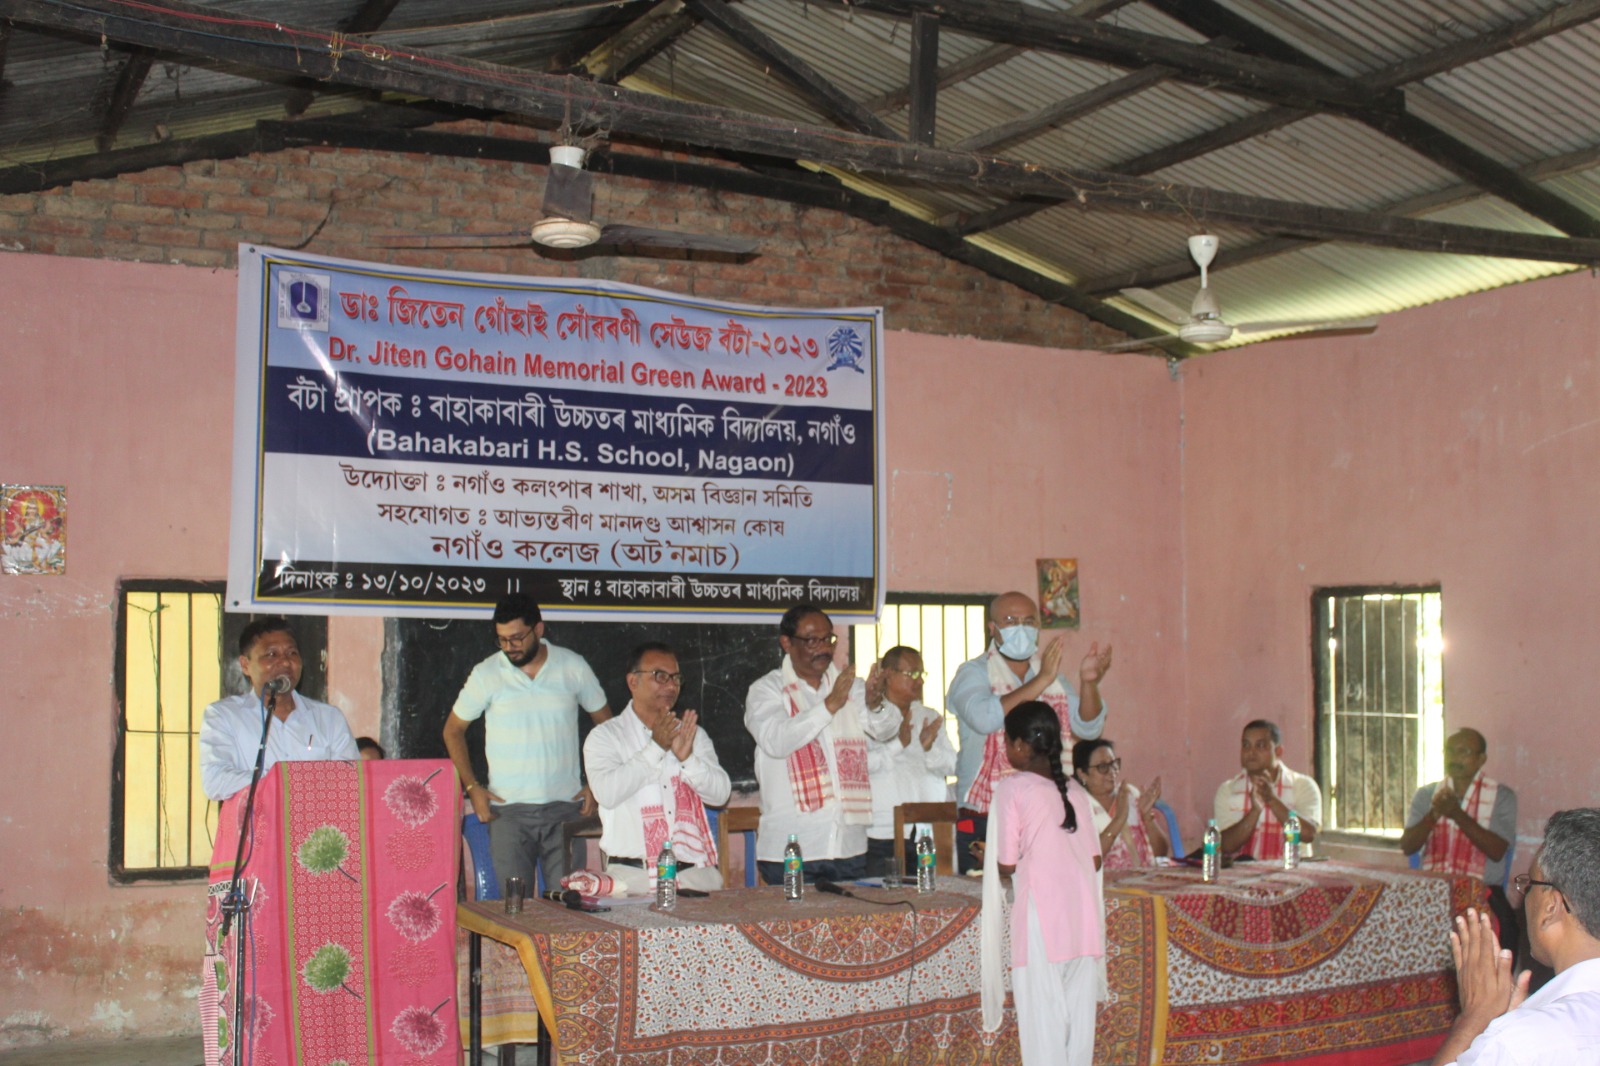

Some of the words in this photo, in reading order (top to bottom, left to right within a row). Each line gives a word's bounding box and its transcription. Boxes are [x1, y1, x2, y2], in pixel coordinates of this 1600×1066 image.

[339, 290, 379, 321] ডাঃ
[387, 286, 465, 329] জিতেন
[474, 296, 549, 340] গোঁহাই
[650, 314, 712, 354] সেউজ
[329, 336, 360, 362] Dr.
[368, 340, 426, 369] Jiten
[435, 346, 516, 374] Gohain
[524, 353, 624, 383] Memorial
[631, 363, 696, 388] Green
[702, 369, 766, 394] Award
[785, 374, 828, 398] 2023
[286, 375, 327, 414] বঁটা
[428, 393, 546, 429] বাহাকাবাৰী
[550, 397, 626, 433] উচ্চতৰ
[632, 403, 715, 439] মাধ্যমিক
[722, 407, 803, 445] বিদ্যালয়,
[808, 415, 856, 446] নগাঁও
[367, 430, 529, 460] (Bahakabari
[538, 440, 588, 462] H.S.
[598, 443, 690, 472] School,
[698, 450, 794, 477] Nagaon)
[339, 461, 428, 492] উদ্যোক্তা
[453, 470, 505, 495] নগাঁও
[512, 478, 592, 500] কলংপাৰ
[598, 482, 647, 505] শাখা,
[653, 485, 695, 504] অসম
[703, 482, 757, 506] বিজ্ঞান
[763, 485, 814, 509] সমিতি
[377, 503, 471, 525] সহযোগত
[493, 505, 593, 532] আভ্যন্তৰীণ
[600, 514, 661, 533] মানদণ্ড
[666, 516, 736, 536] আশ্বাসন
[743, 519, 785, 537] কোষ
[430, 529, 504, 561] নগাঁও
[513, 540, 601, 567] কলেজ
[279, 567, 339, 590] দিনাংক
[362, 570, 486, 595] ১৩/১০/২০২৩
[559, 578, 589, 601] স্থান
[606, 575, 686, 601] বাহাকাবাৰী
[688, 577, 741, 601] উচ্চতৰ
[746, 578, 803, 602] মাধ্যমিক
[809, 579, 860, 603] বিদ্যালয়
